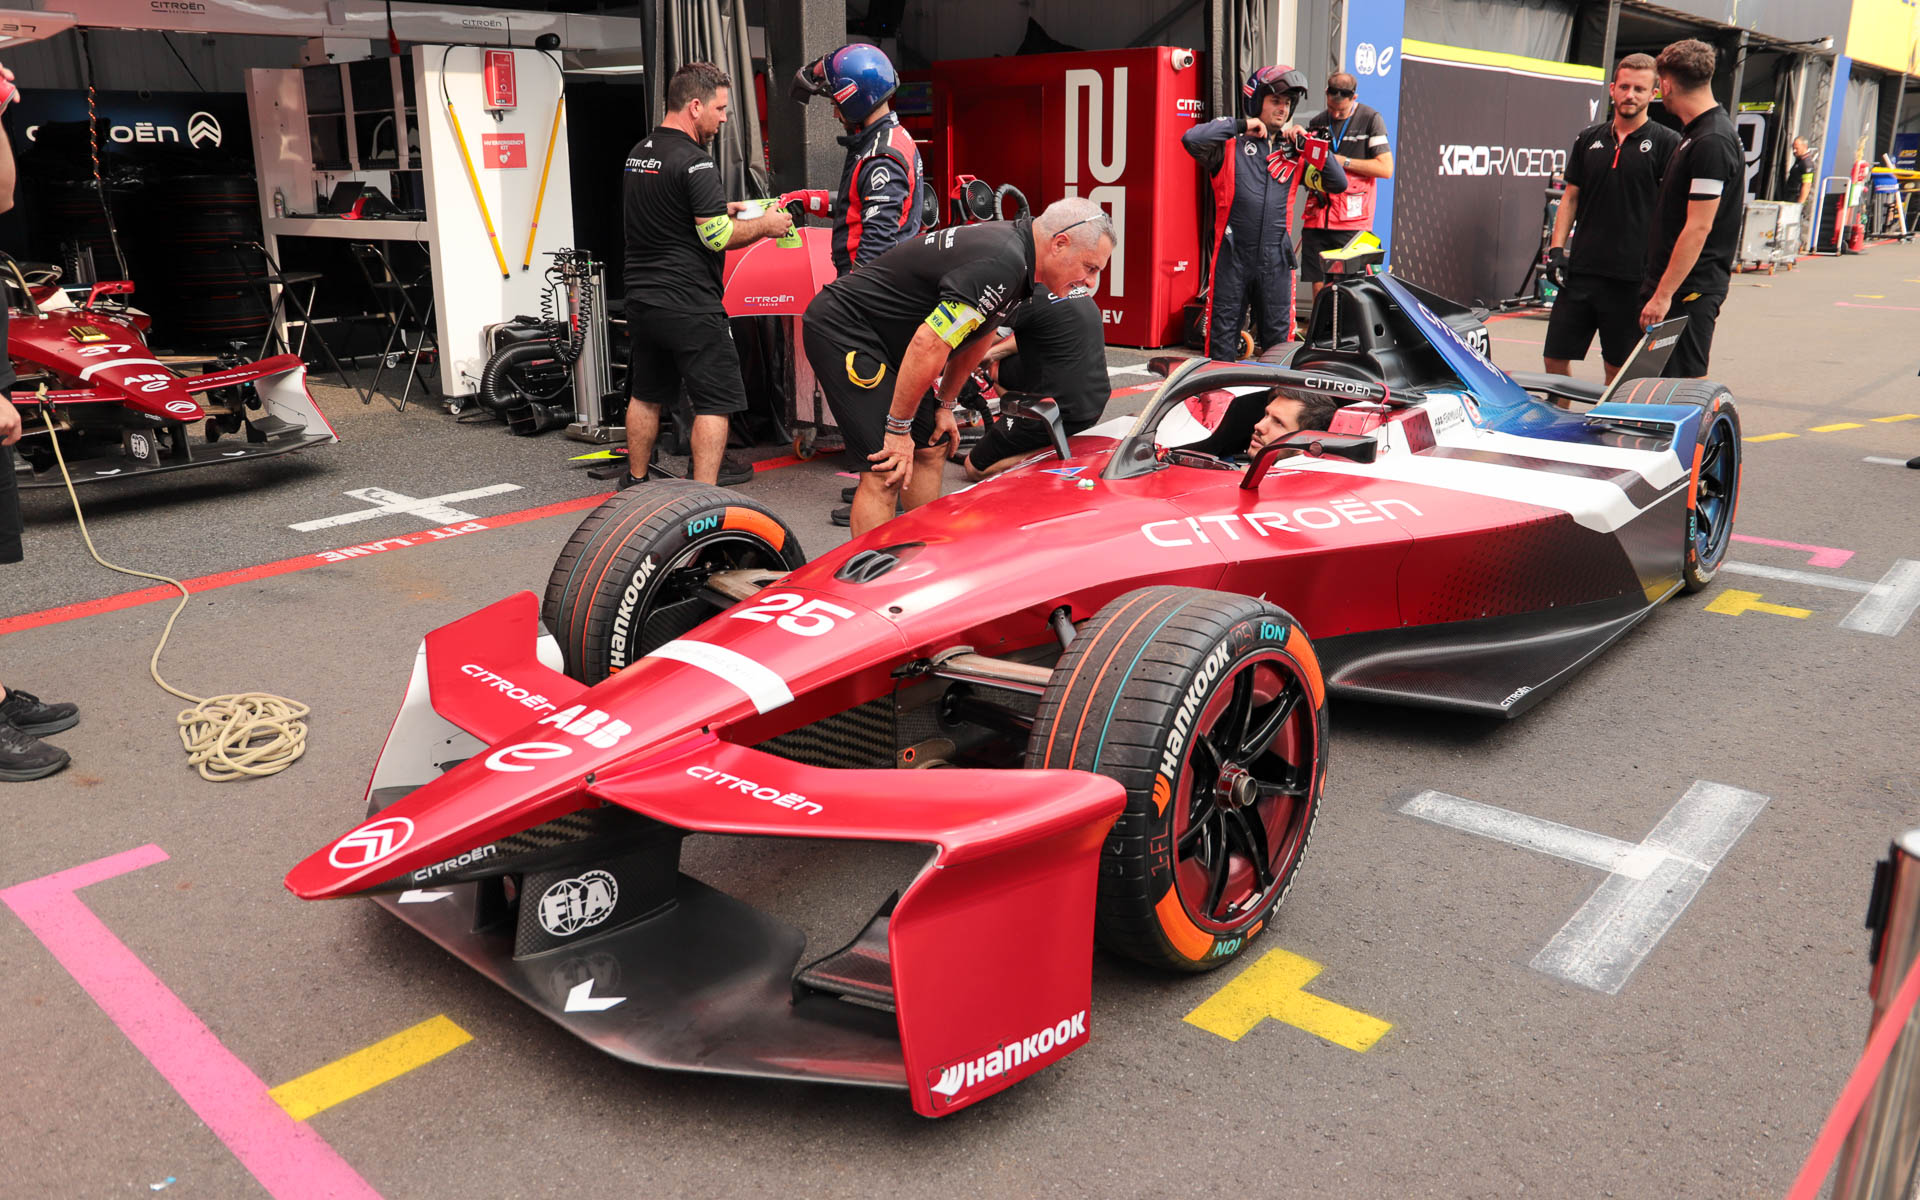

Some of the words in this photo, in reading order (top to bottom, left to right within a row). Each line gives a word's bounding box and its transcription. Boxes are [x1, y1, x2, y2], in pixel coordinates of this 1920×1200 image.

[2, 24, 37, 33] 37
[744, 294, 795, 303] CITROËN
[77, 343, 132, 357] 37
[123, 373, 171, 386] ABB
[1304, 376, 1372, 398] CITROËN
[1139, 498, 1425, 548] CITROËN
[730, 592, 857, 638] 25
[537, 703, 632, 749] ABB
[686, 764, 825, 817] CITROËN
[414, 843, 497, 882] CITROËN
[541, 877, 615, 932] FIA
